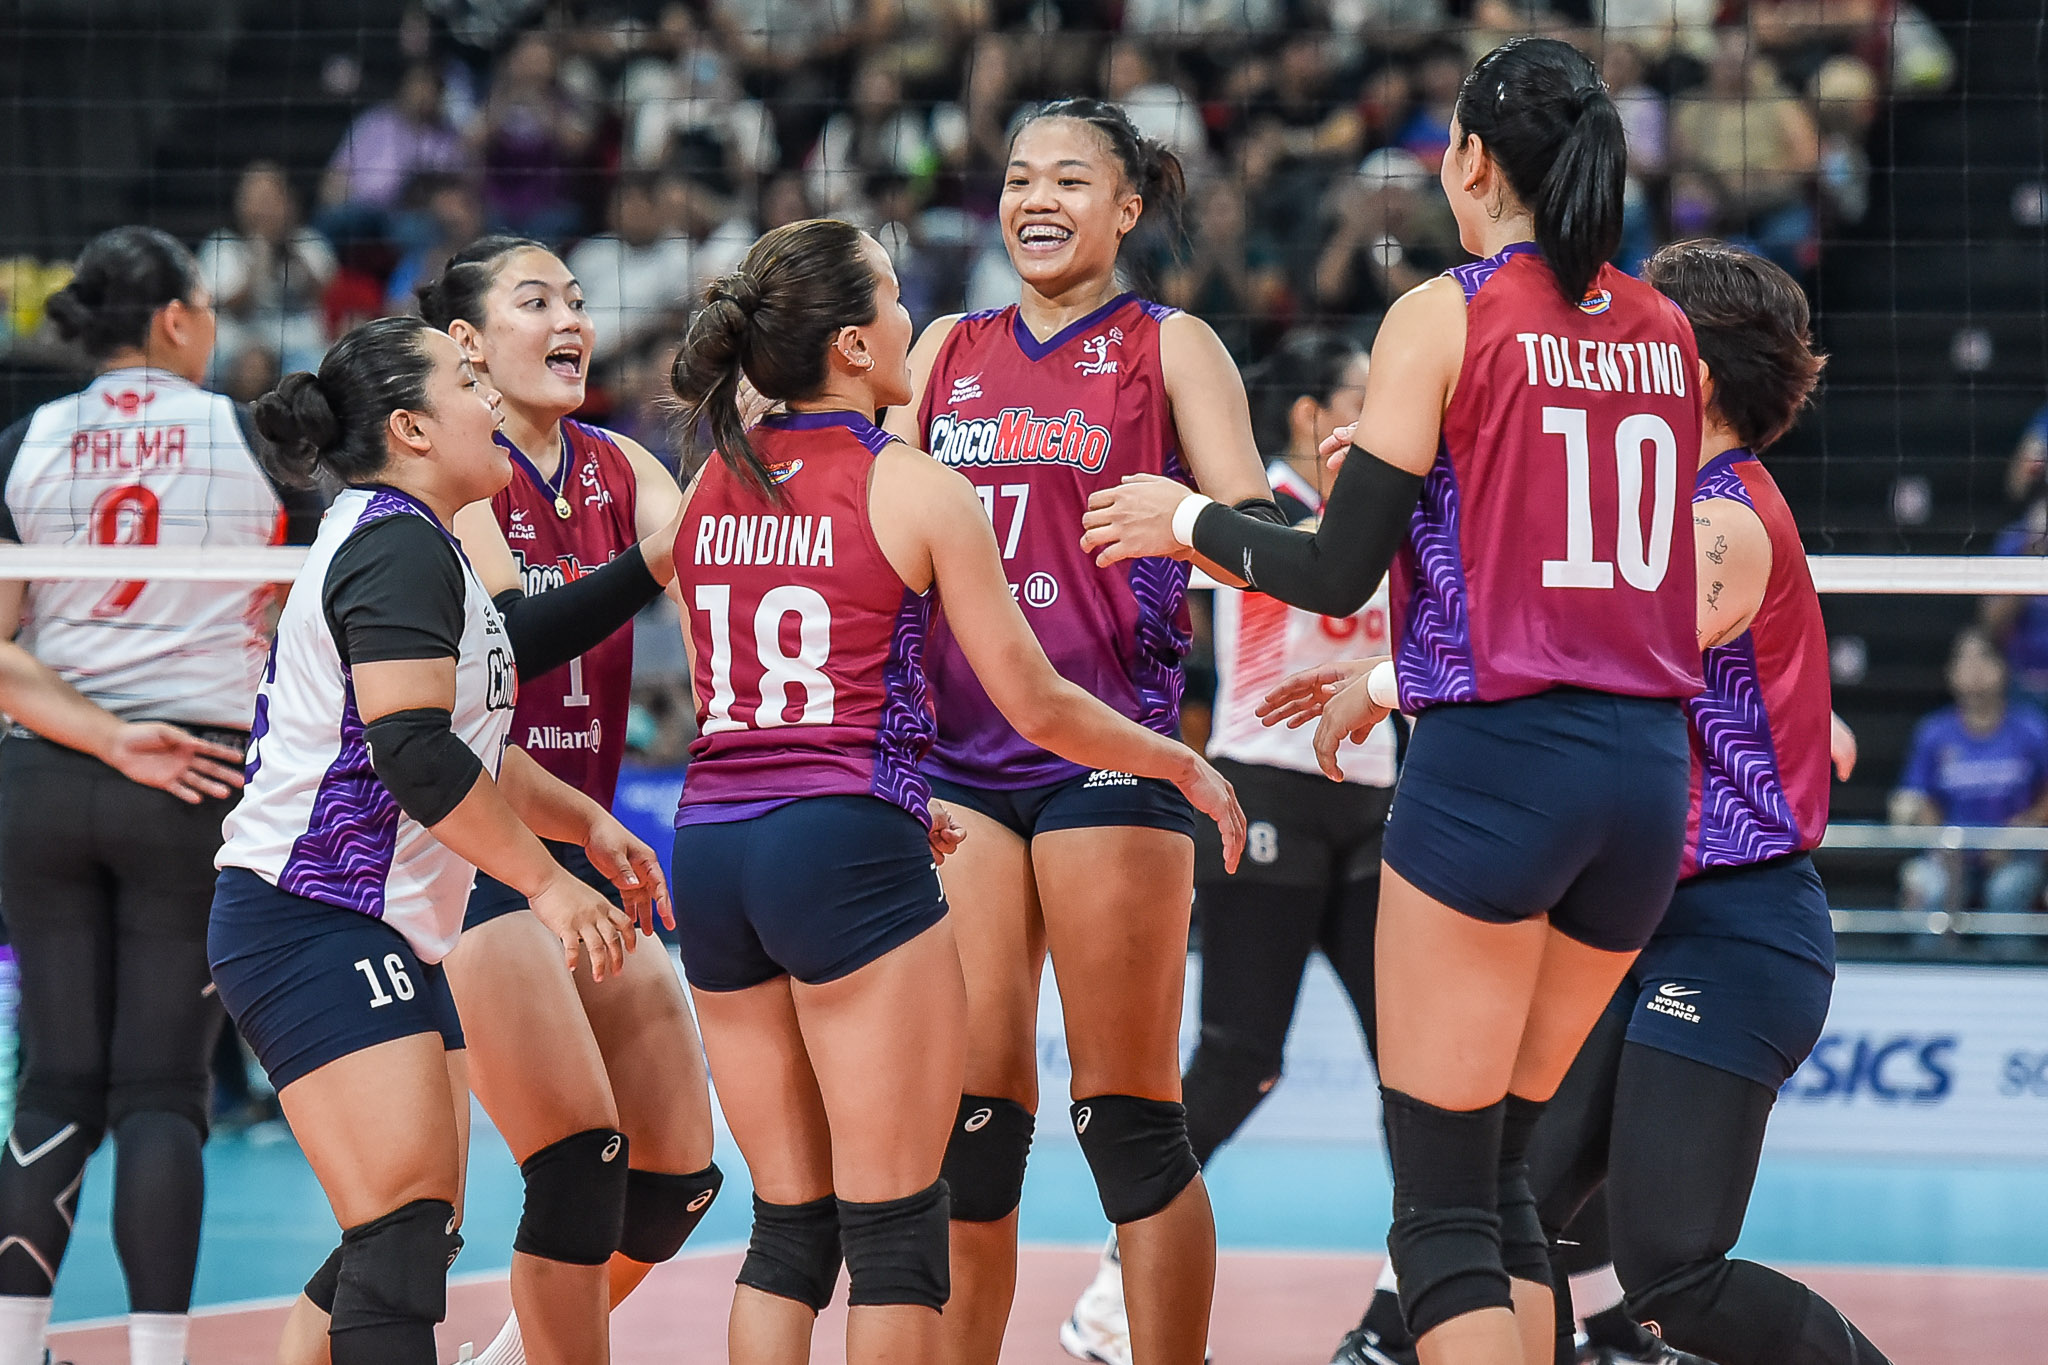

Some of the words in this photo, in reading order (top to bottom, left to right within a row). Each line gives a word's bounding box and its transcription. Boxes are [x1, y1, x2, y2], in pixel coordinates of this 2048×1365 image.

[1101, 361, 1118, 375] PVL
[1516, 332, 1686, 398] TOLENTINO
[71, 424, 185, 469] PALMA
[1542, 406, 1677, 592] 10
[694, 515, 834, 567] RONDINA
[695, 584, 836, 736] 18
[1248, 821, 1279, 864] 8
[353, 953, 415, 1009] 16
[1654, 995, 1696, 1013] WORLD
[1646, 1001, 1701, 1024] BALANCE
[1778, 1034, 1957, 1104] SICS
